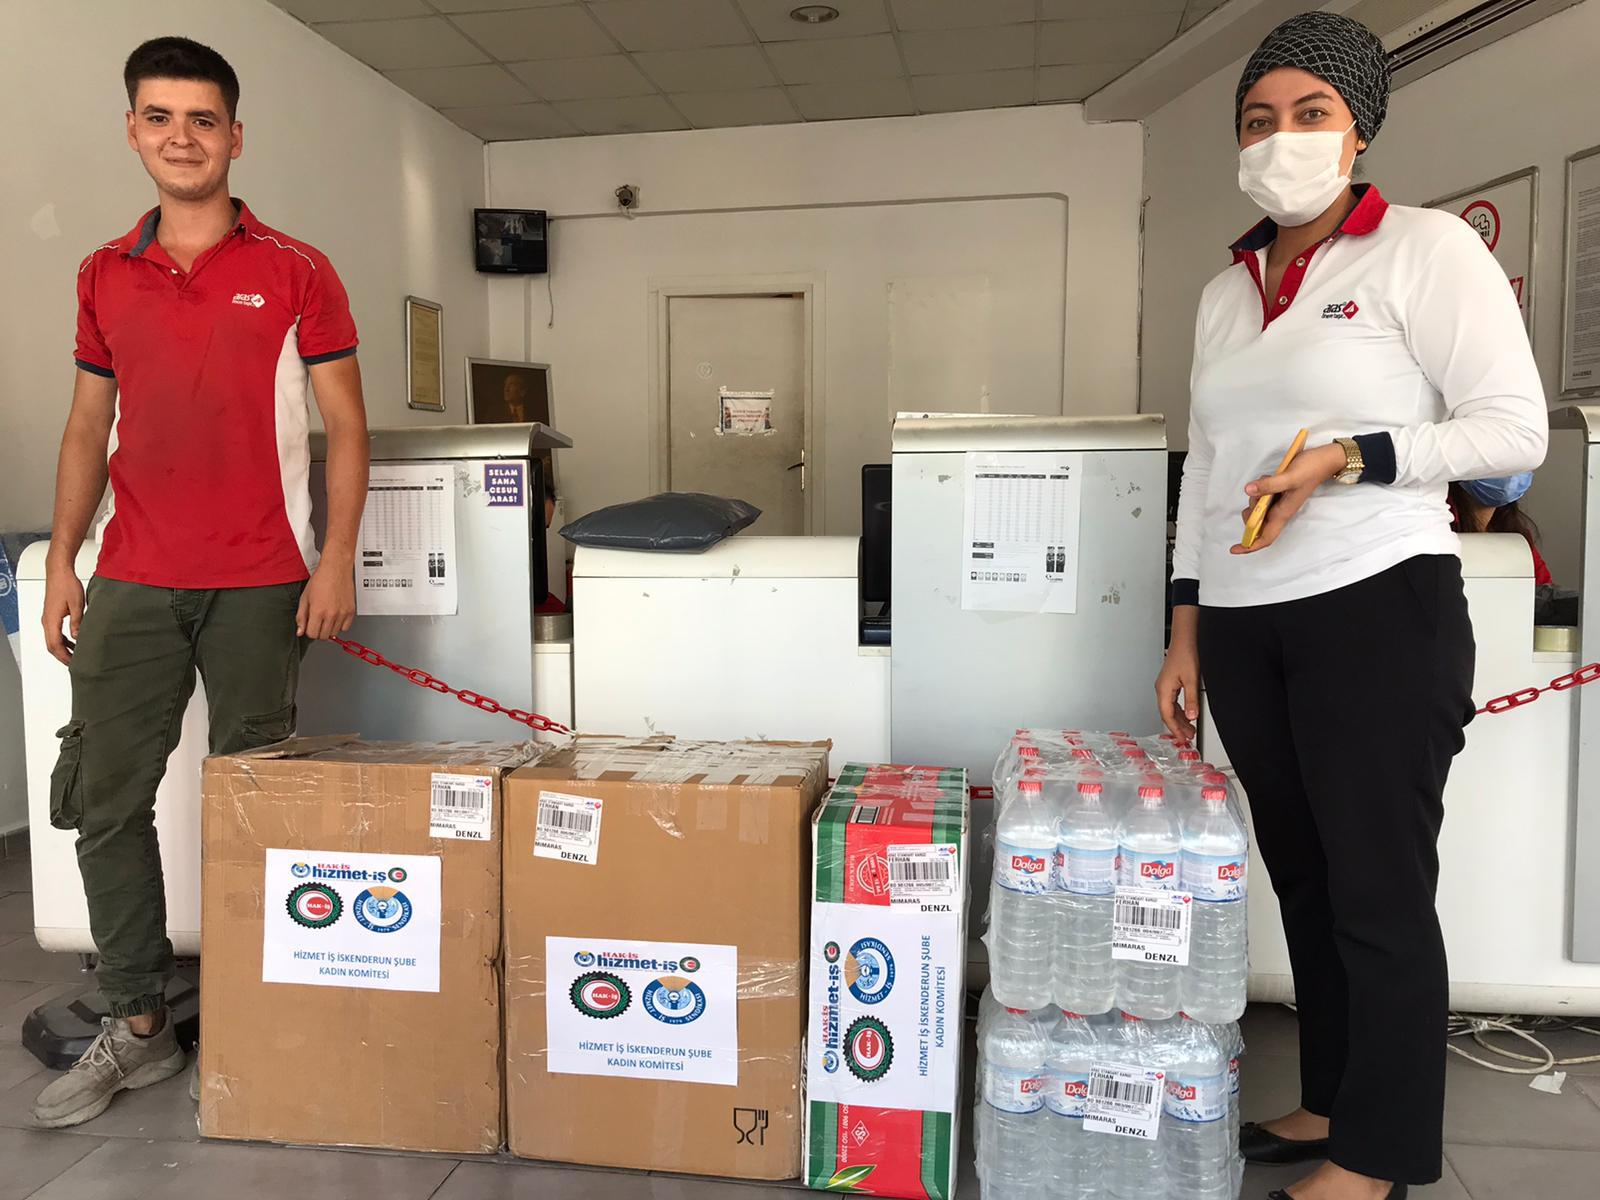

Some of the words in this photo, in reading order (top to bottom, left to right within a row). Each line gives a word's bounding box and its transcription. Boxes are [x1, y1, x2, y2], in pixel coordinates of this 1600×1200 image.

[455, 830, 484, 839] DENZL
[561, 851, 590, 862] DENZL
[1013, 858, 1044, 874] Dalga
[1142, 864, 1173, 879] Dalga
[1220, 866, 1241, 879] Dalg
[312, 866, 387, 883] hizmet-iş
[920, 904, 952, 912] DENZL
[922, 935, 932, 962] ŞUBE
[293, 949, 326, 961] HİZMET
[328, 951, 335, 963] İŞ
[337, 951, 392, 965] İSKENDERUN
[394, 957, 417, 968] ŞUBE
[597, 954, 678, 973] hizmet-iş
[1144, 952, 1179, 963] DENZL
[319, 966, 346, 977] KADIN
[348, 967, 390, 979] KOMİTESİ
[919, 964, 931, 1026] İSKENDERUN
[936, 966, 945, 1012] KOMİTESİ
[826, 964, 842, 1049] hizmet-iş
[919, 1027, 930, 1039] İŞ
[935, 1017, 944, 1048] KADIN
[579, 1040, 614, 1052] HİZMET
[616, 1042, 625, 1054] İŞ
[627, 1043, 686, 1057] İSKENDERUN
[688, 1048, 713, 1059] ŞUBE
[607, 1057, 637, 1068] KADIN
[639, 1058, 684, 1071] KOMİTESİ
[918, 1041, 929, 1077] HİZMET
[1090, 1071, 1114, 1079] FERHAN
[1115, 1125, 1148, 1138] DENZL
